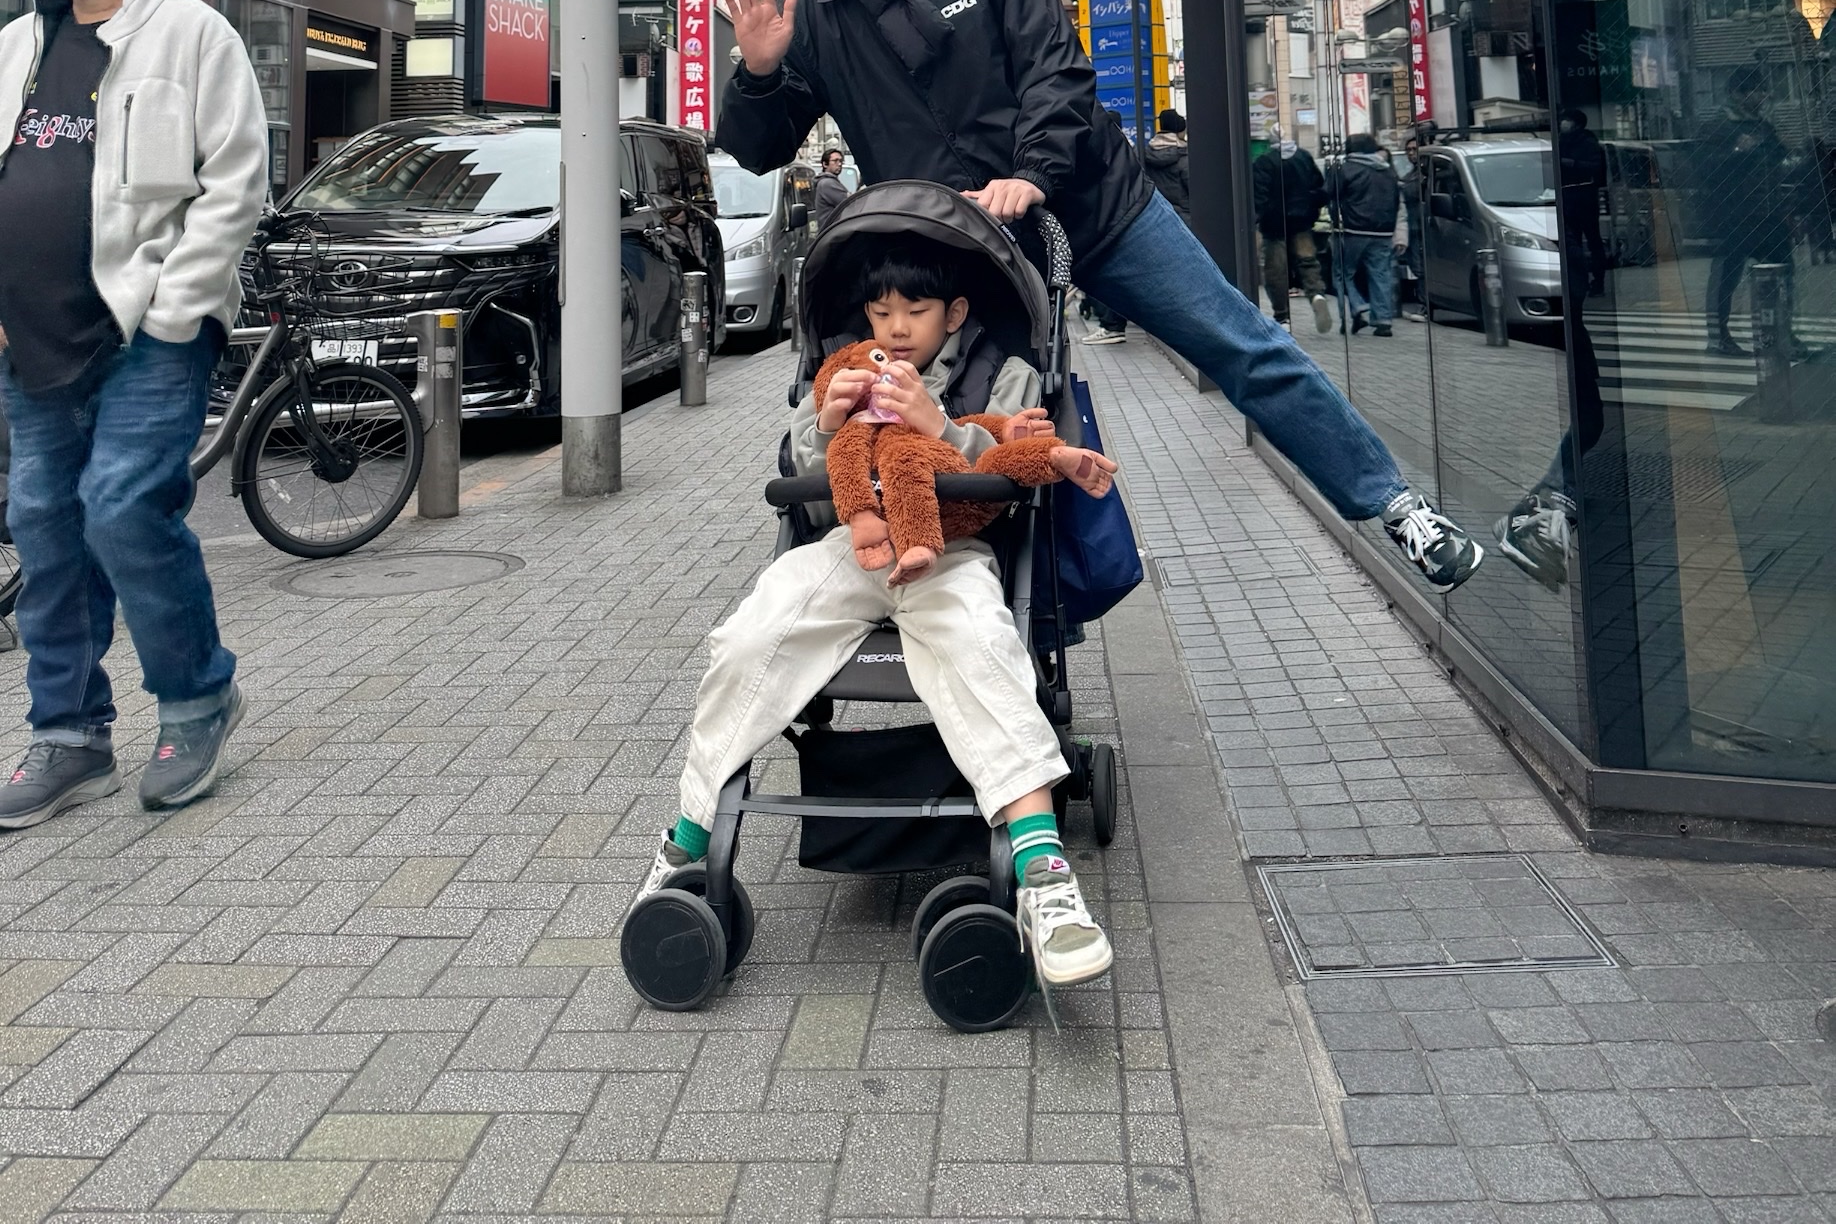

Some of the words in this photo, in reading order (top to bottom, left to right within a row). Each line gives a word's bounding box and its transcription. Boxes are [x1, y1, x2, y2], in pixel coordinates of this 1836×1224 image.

[488, 6, 545, 42] SHACK
[685, 62, 704, 130] 歌広場
